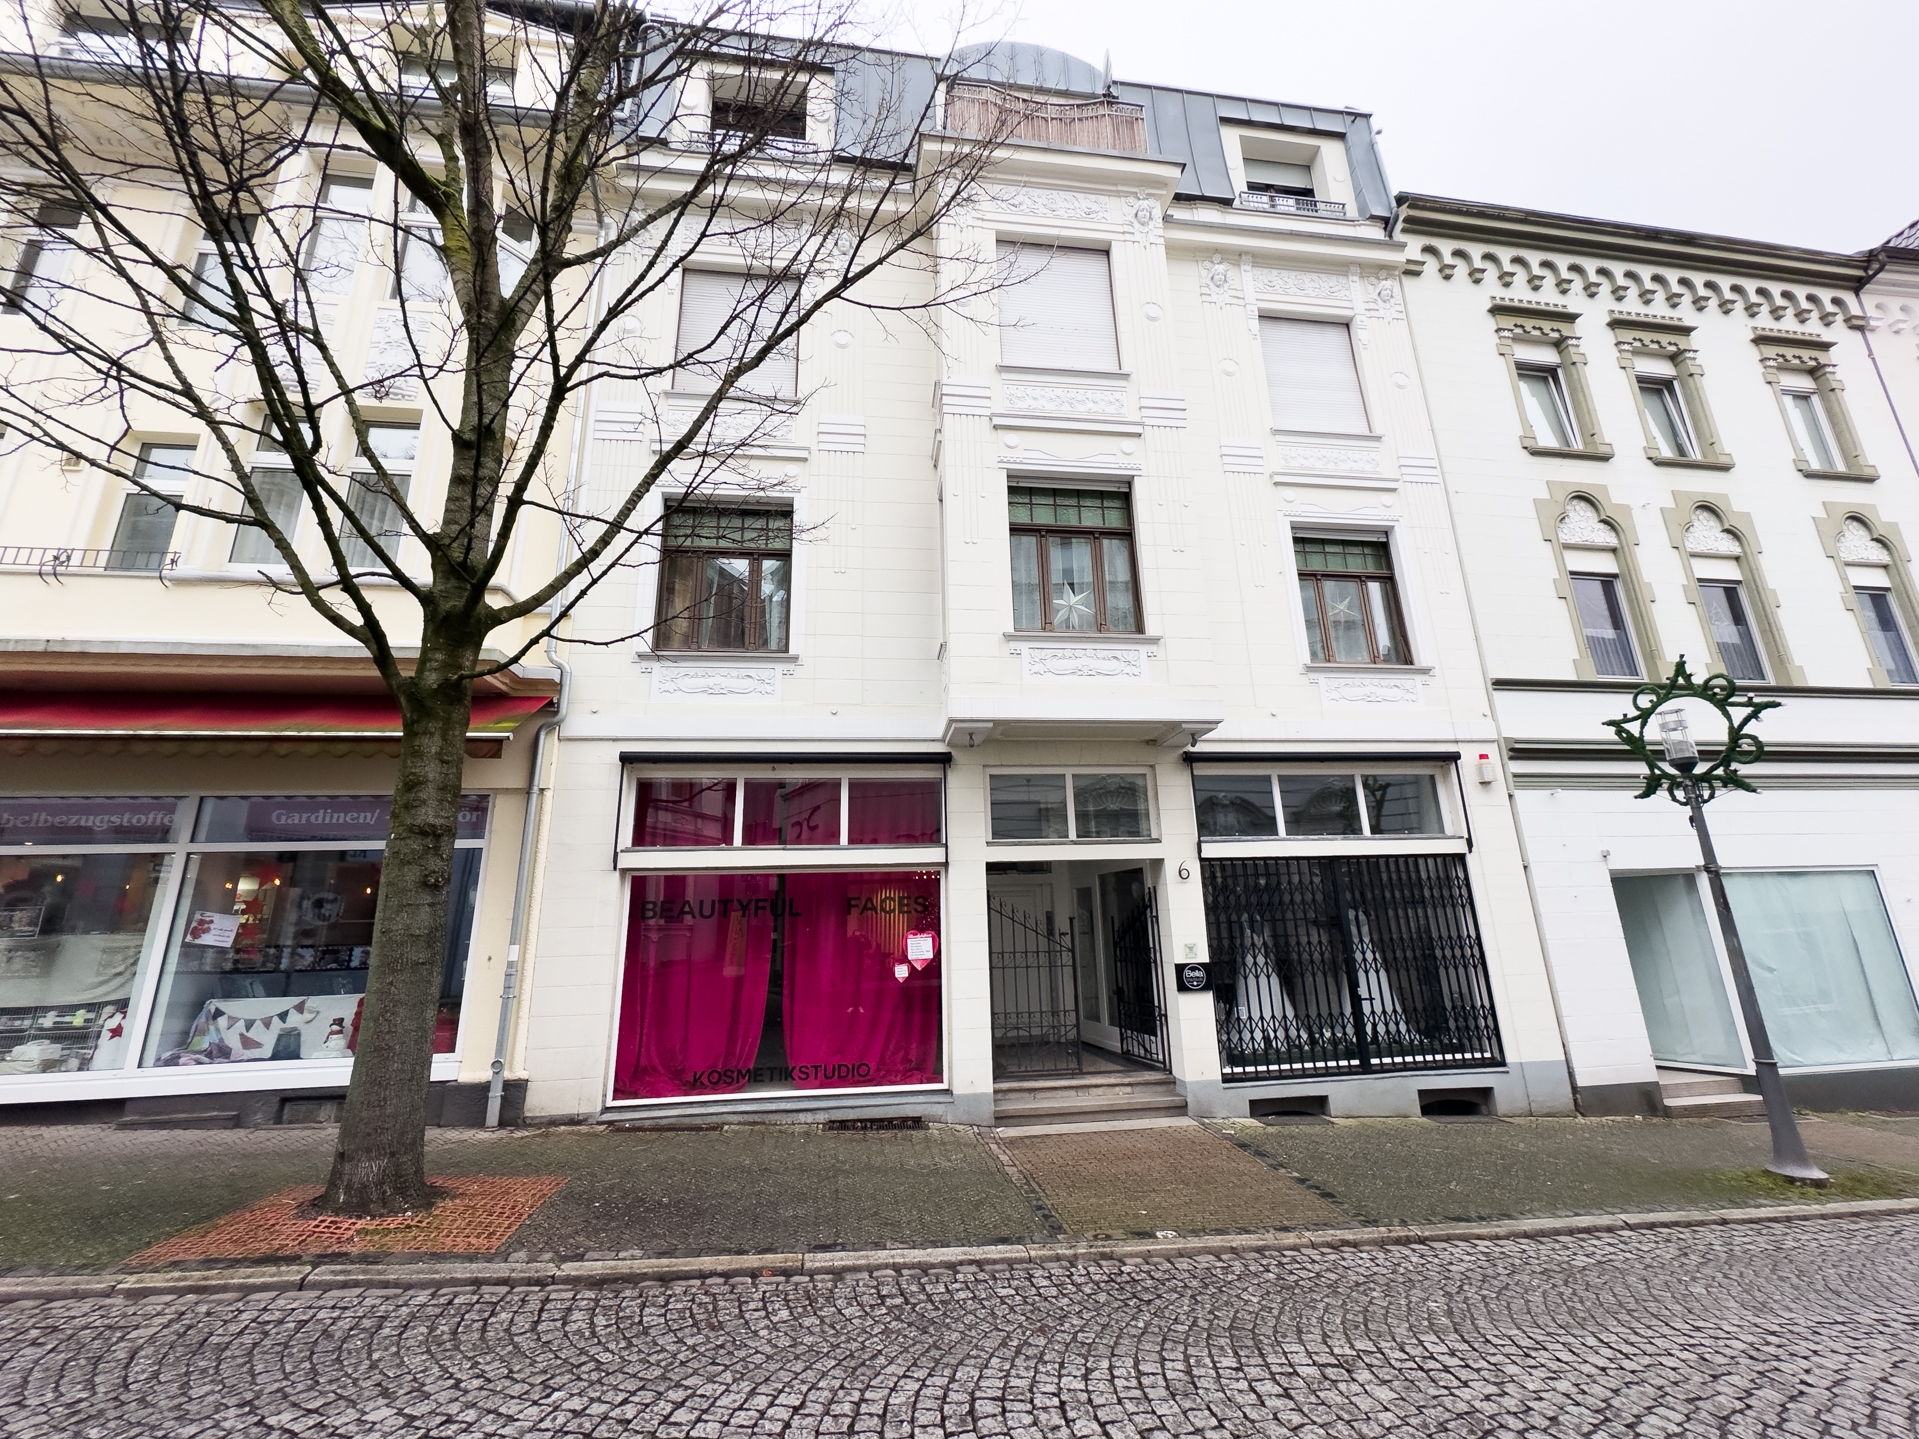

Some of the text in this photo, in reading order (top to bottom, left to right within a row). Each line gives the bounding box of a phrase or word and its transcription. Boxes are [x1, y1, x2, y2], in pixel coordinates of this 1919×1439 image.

[271, 809, 380, 825] Gardinen/
[1178, 860, 1190, 880] 6
[641, 894, 929, 920] BEAUTYFUL FACES
[692, 1062, 871, 1087] KOSMETIKSTUDIO
